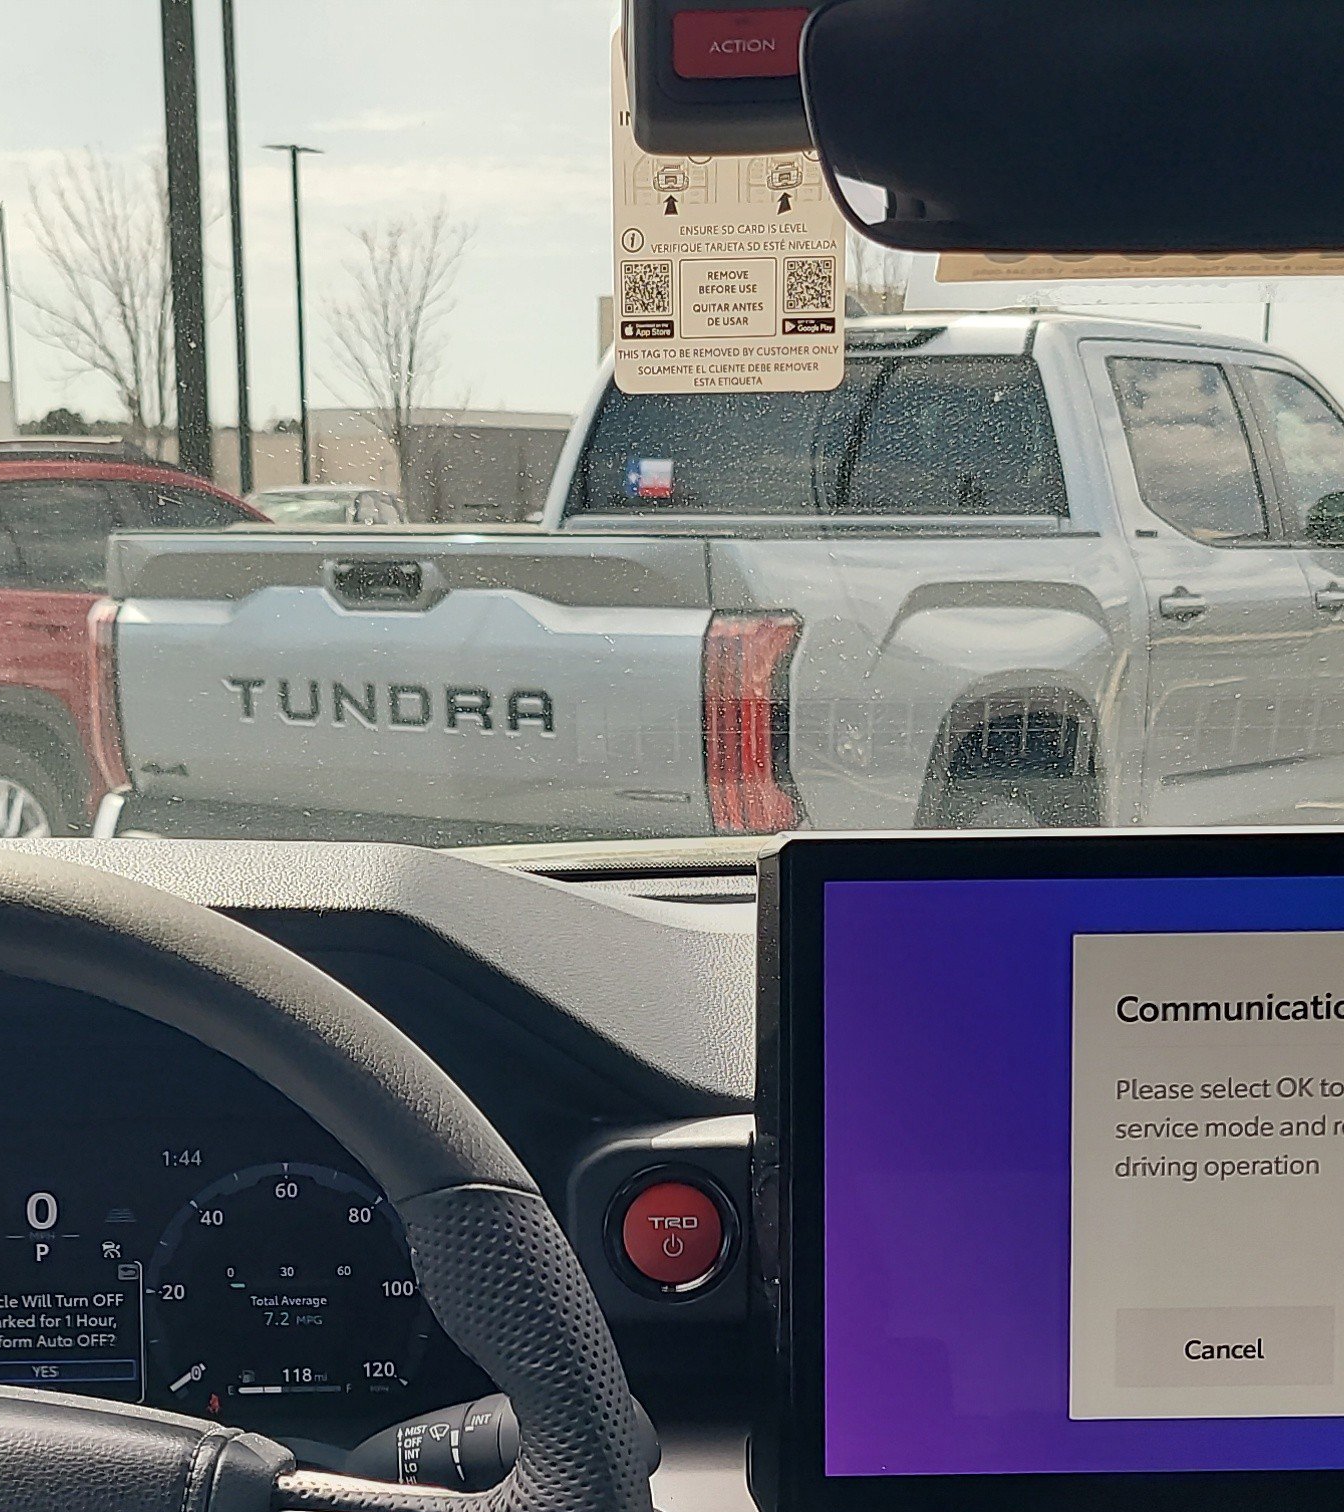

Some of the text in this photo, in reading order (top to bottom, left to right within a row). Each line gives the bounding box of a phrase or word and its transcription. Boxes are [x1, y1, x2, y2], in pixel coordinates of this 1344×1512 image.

[709, 38, 776, 53] ACTION
[679, 223, 807, 236] ENSURE SD CARD IS LEVEL
[651, 238, 837, 253] VERIFIQUE TARJETA SD ESTÉ NIVELADA
[707, 270, 749, 280] REMOVE
[699, 284, 757, 294] BEFORE USE
[692, 301, 764, 313] QUITAR ANTES
[707, 316, 749, 326] DE USAR
[797, 322, 833, 333] Google Play
[636, 327, 671, 337] App Store
[618, 345, 839, 360] THIS TAG TO BE REMOVED BY CUSTOMER ONLY
[638, 362, 819, 375] SOLAMENTE EL CLIENTE DEBE REMOVER
[693, 376, 763, 387] ESTA ETIQUETA
[224, 676, 554, 736] TUNDRA
[1116, 1077, 1195, 1100] Please
[1200, 1076, 1271, 1099] select
[1276, 1077, 1313, 1098] OK
[1320, 1078, 1344, 1097] to
[1115, 1115, 1199, 1140] service
[1205, 1116, 1273, 1138] mode
[1279, 1115, 1326, 1137] and
[161, 1151, 202, 1166] 1:44
[1115, 1153, 1320, 1181] driving operation
[275, 1182, 298, 1198] 60
[27, 1192, 57, 1230] 0
[200, 1209, 224, 1226] 40
[348, 1207, 371, 1223] 80
[647, 1217, 698, 1229] TRD
[36, 1243, 49, 1261] P
[227, 1267, 235, 1277] 0
[280, 1266, 295, 1277] 30
[337, 1265, 352, 1276] 60
[162, 1284, 185, 1300] 20
[382, 1281, 414, 1297] 100
[21, 1294, 52, 1308] Will
[55, 1294, 89, 1308] Turn
[92, 1294, 124, 1307] OFF
[250, 1296, 327, 1309] Total Average
[39, 1315, 61, 1328] for
[65, 1314, 72, 1327] 1
[76, 1314, 117, 1328] Hour,
[264, 1312, 323, 1326] 7.2 MPG
[36, 1334, 73, 1348] Auto
[77, 1334, 116, 1348] OFF?
[1184, 1338, 1264, 1361] Cancel
[32, 1366, 59, 1378] YES
[282, 1368, 312, 1382] 118
[363, 1362, 395, 1377] 120
[227, 1385, 234, 1395] E
[472, 1414, 492, 1426] INT
[405, 1424, 427, 1436] MIST
[404, 1436, 422, 1448] OFF
[404, 1448, 420, 1460] INT
[405, 1462, 417, 1473] LO
